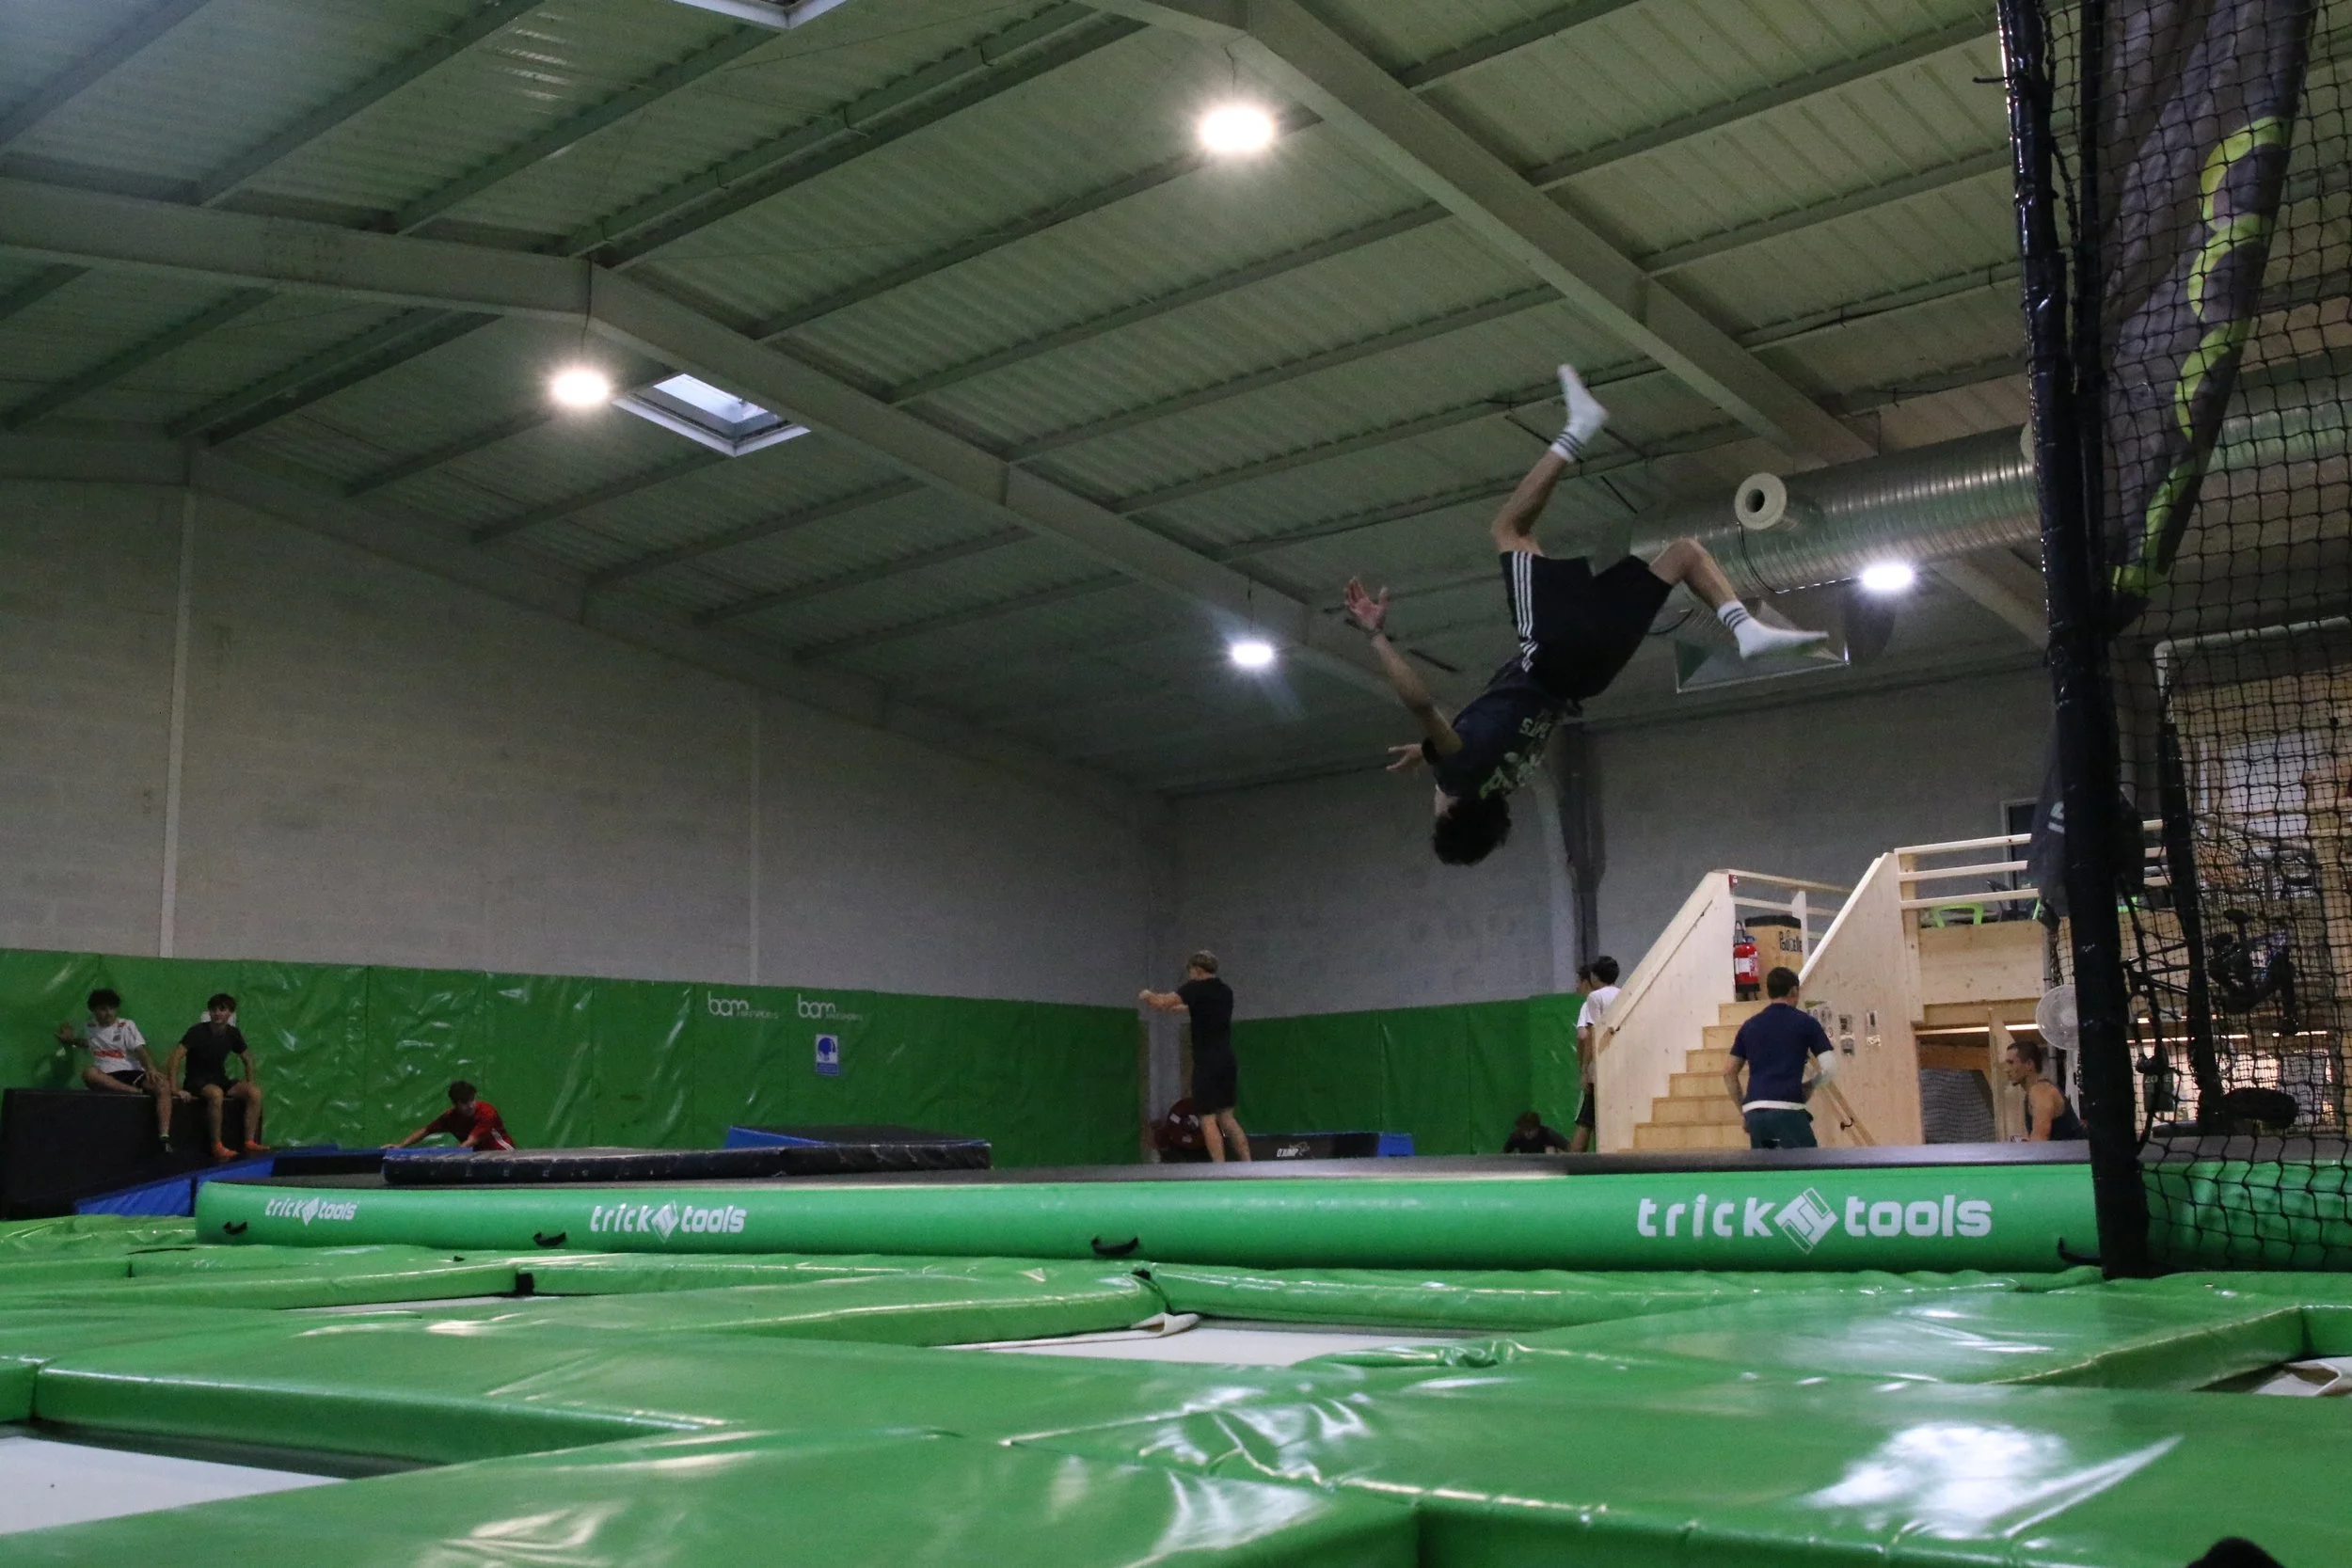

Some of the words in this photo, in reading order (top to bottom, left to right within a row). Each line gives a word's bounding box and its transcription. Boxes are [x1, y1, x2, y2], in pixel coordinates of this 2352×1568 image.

[264, 1197, 305, 1218] trick
[318, 1201, 358, 1220] tools
[590, 1203, 655, 1232] trick
[680, 1204, 747, 1233] tools
[1637, 1194, 1776, 1238] trick
[1844, 1194, 1993, 1238] tools
